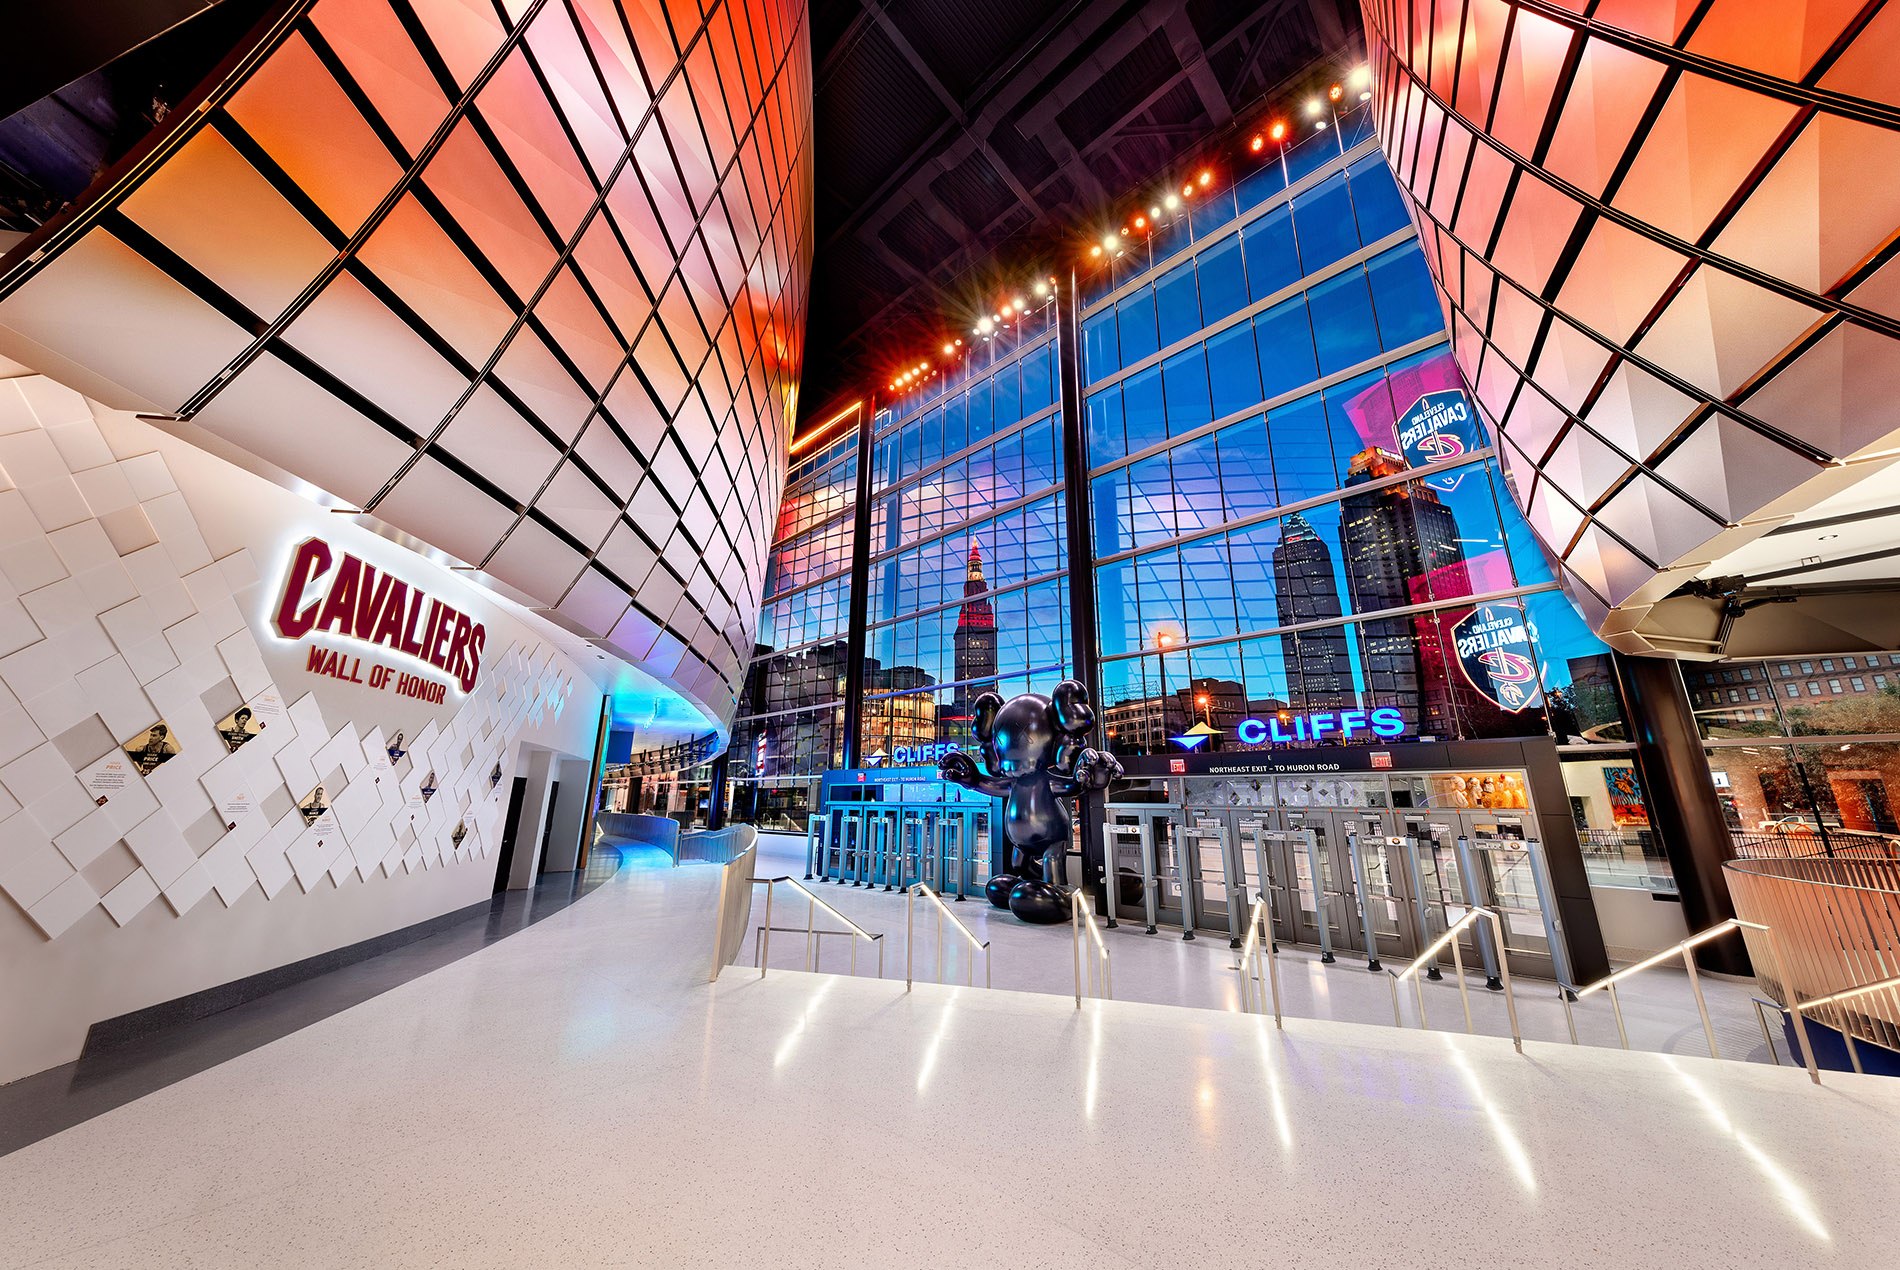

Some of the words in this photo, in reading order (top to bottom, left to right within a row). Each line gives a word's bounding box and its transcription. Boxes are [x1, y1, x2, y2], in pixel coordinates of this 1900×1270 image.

[270, 536, 486, 694] CAVALIERS
[306, 645, 363, 684] WALL
[369, 664, 395, 690] OF
[396, 672, 447, 705] HONOR
[1238, 708, 1405, 744] CLIFFS
[1317, 763, 1340, 771] ROAD
